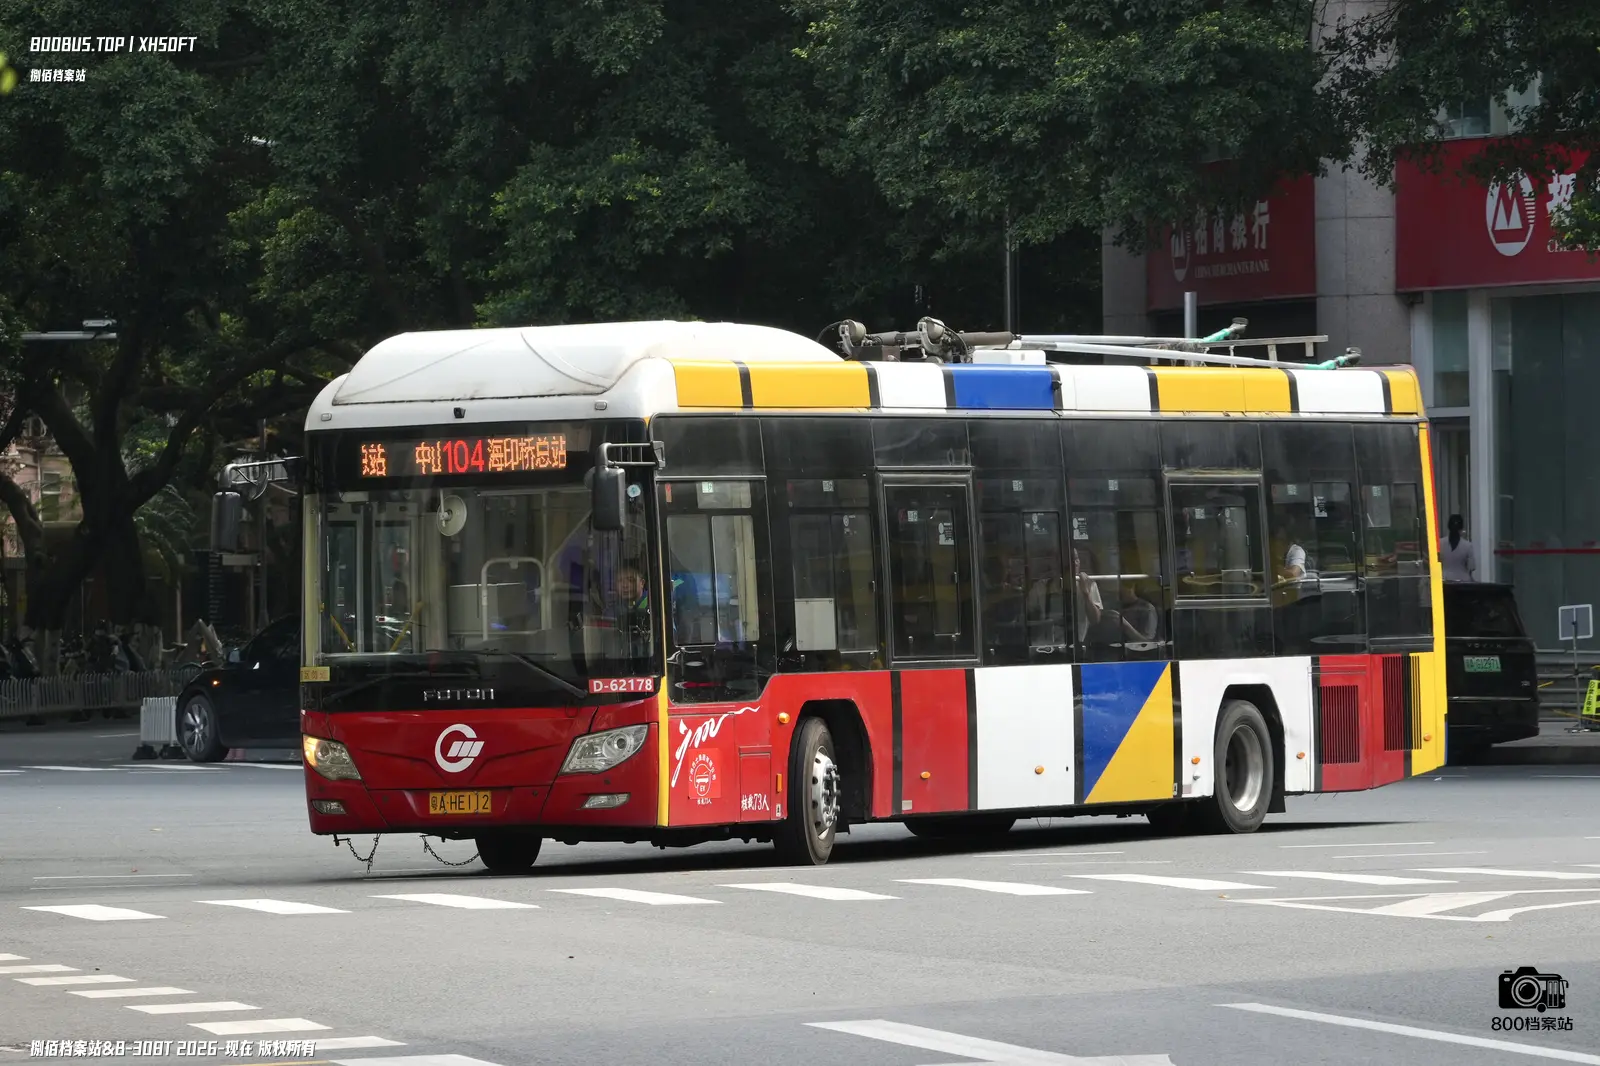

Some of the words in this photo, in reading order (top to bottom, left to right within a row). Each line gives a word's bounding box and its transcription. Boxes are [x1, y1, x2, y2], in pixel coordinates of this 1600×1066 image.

[443, 439, 485, 474] 104
[487, 435, 567, 472] 海印桥总站
[593, 679, 653, 692] D-62178
